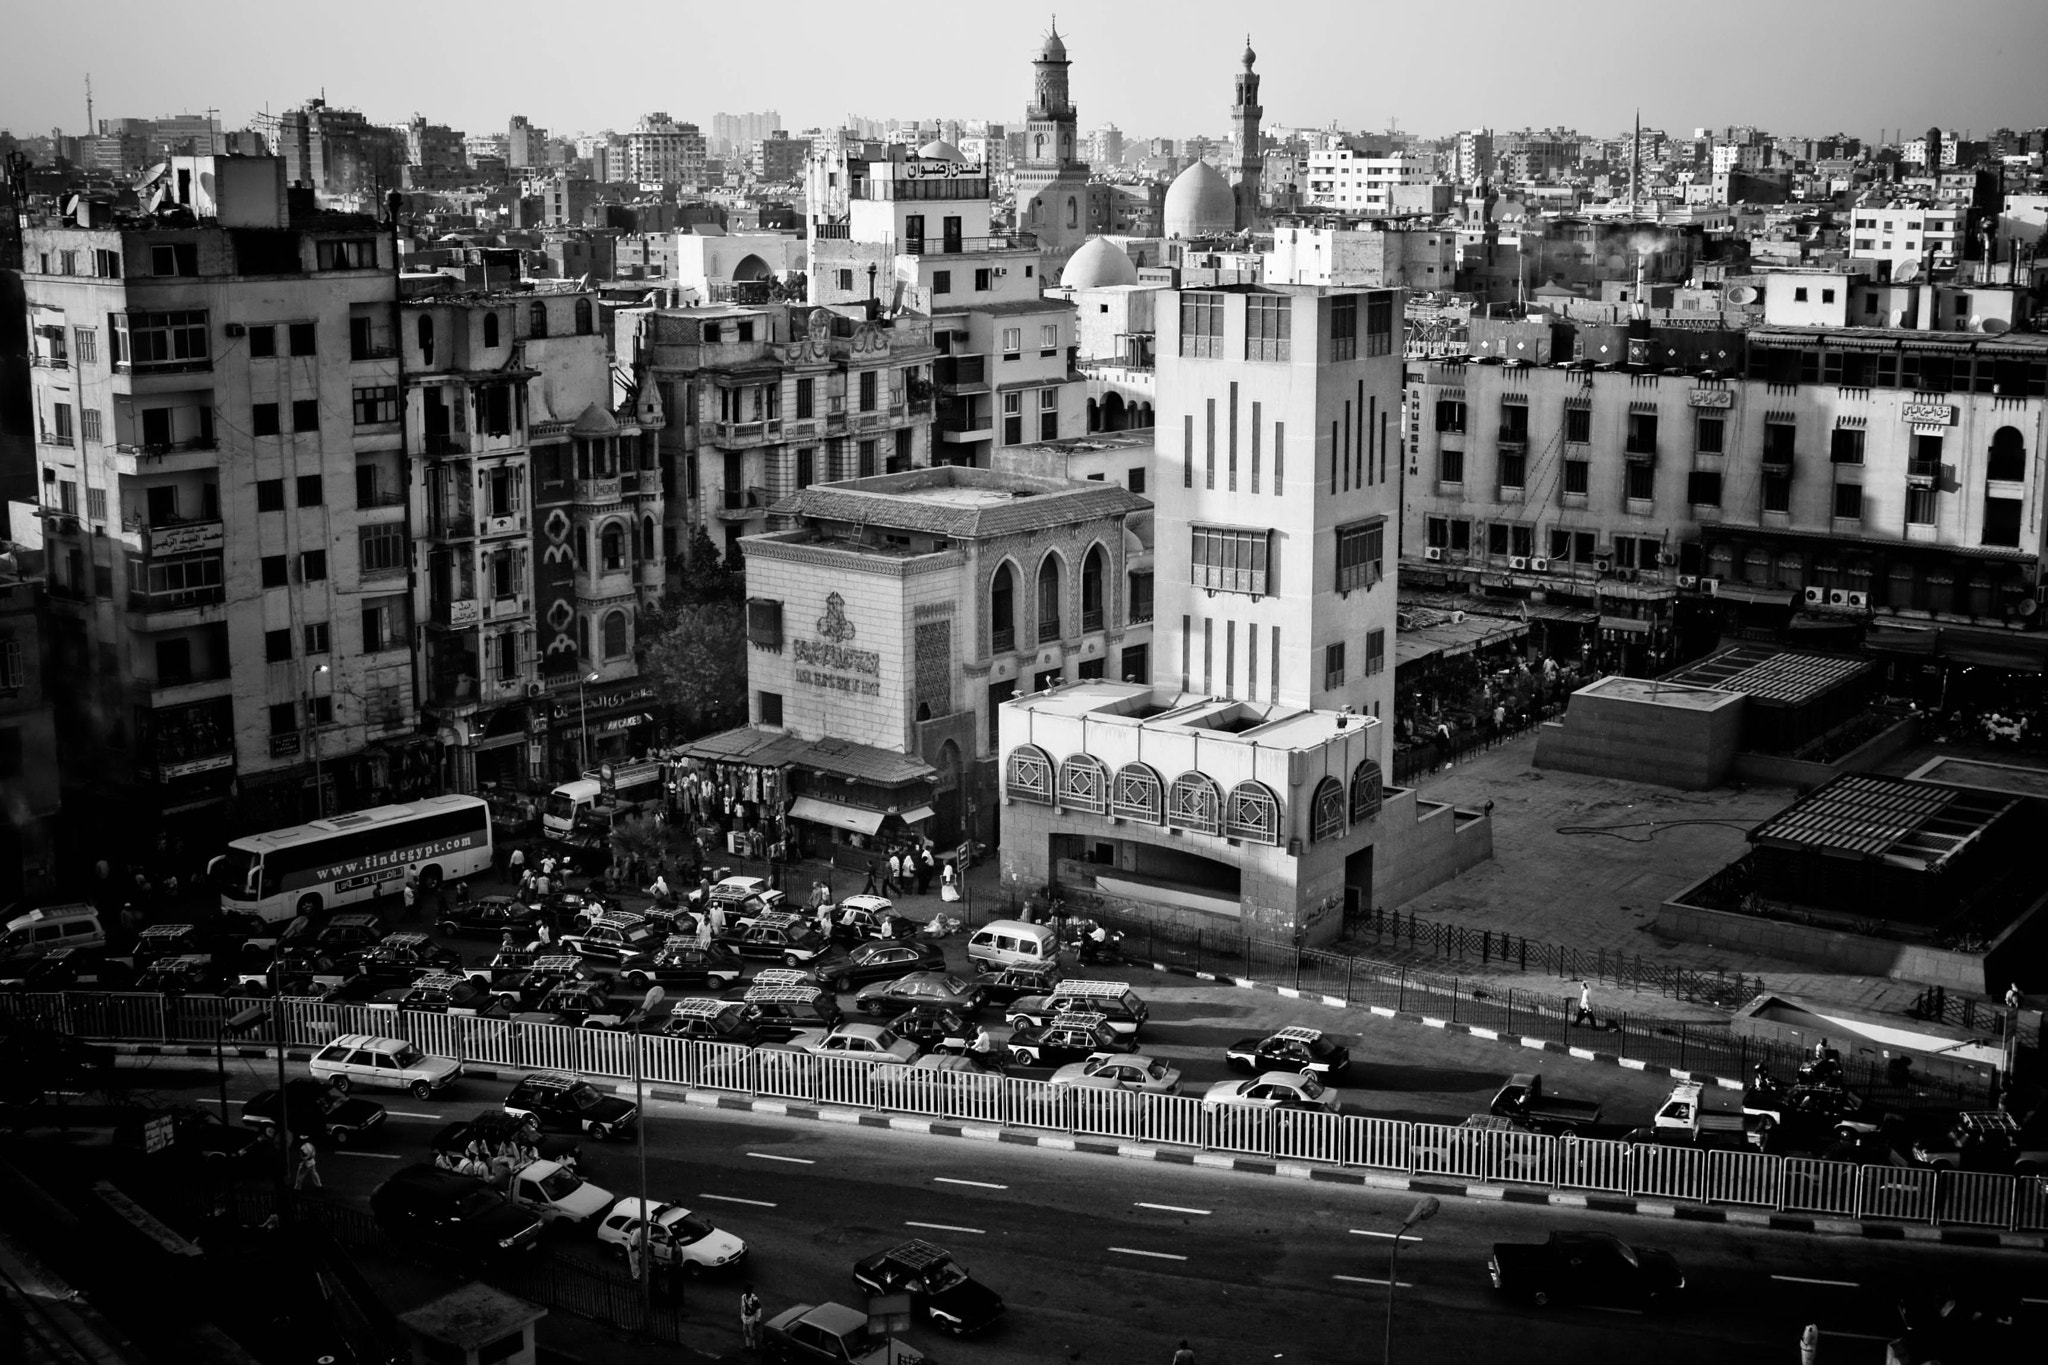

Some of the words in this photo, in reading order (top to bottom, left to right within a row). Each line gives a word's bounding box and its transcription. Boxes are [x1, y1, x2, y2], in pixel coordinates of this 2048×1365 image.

[908, 162, 950, 178] رضوان
[951, 162, 981, 178] فندق
[1936, 406, 1950, 419] فندق
[1409, 401, 1420, 476] HUSSEIN
[316, 835, 472, 880] www.findegypt.com
